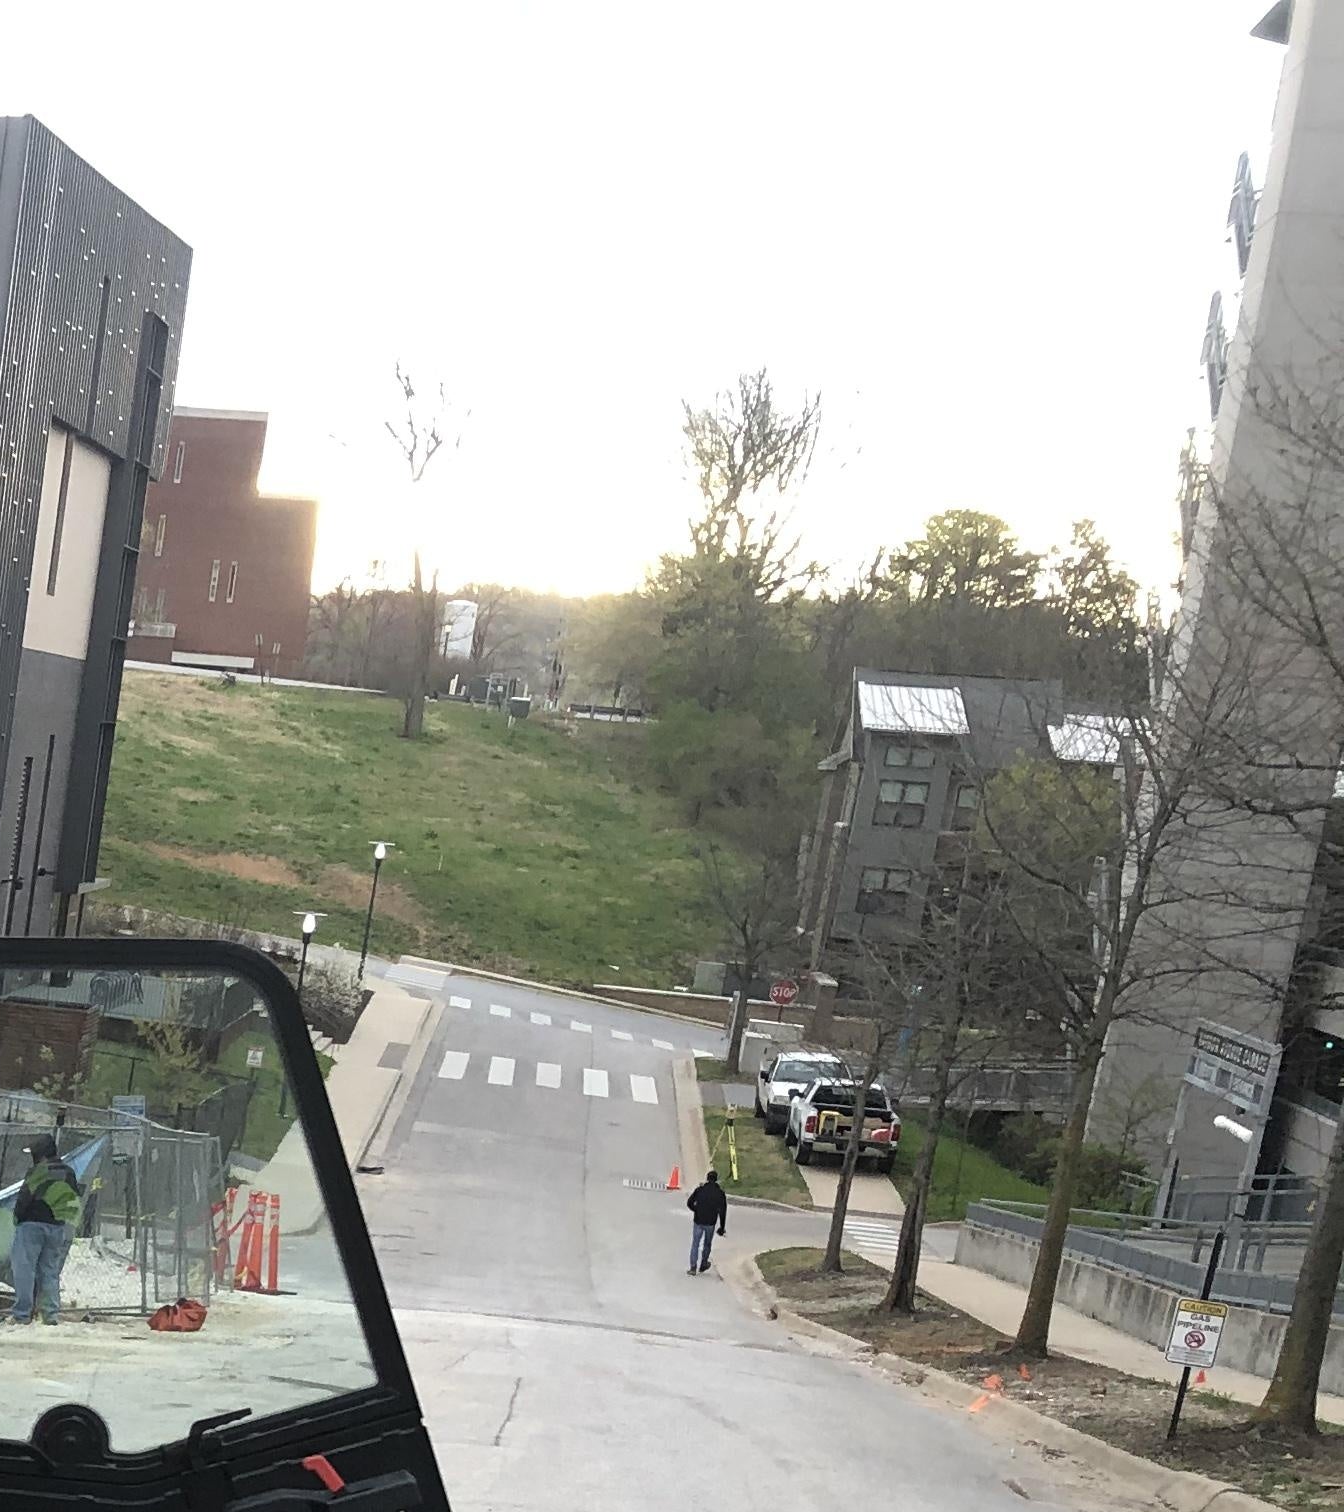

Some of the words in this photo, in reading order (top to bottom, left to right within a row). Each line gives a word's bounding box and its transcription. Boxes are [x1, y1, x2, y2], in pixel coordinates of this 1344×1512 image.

[772, 986, 796, 998] STOP
[1184, 1302, 1223, 1314] CAUTION
[1190, 1314, 1211, 1322] GAS
[1177, 1321, 1220, 1334] PIPELINE
